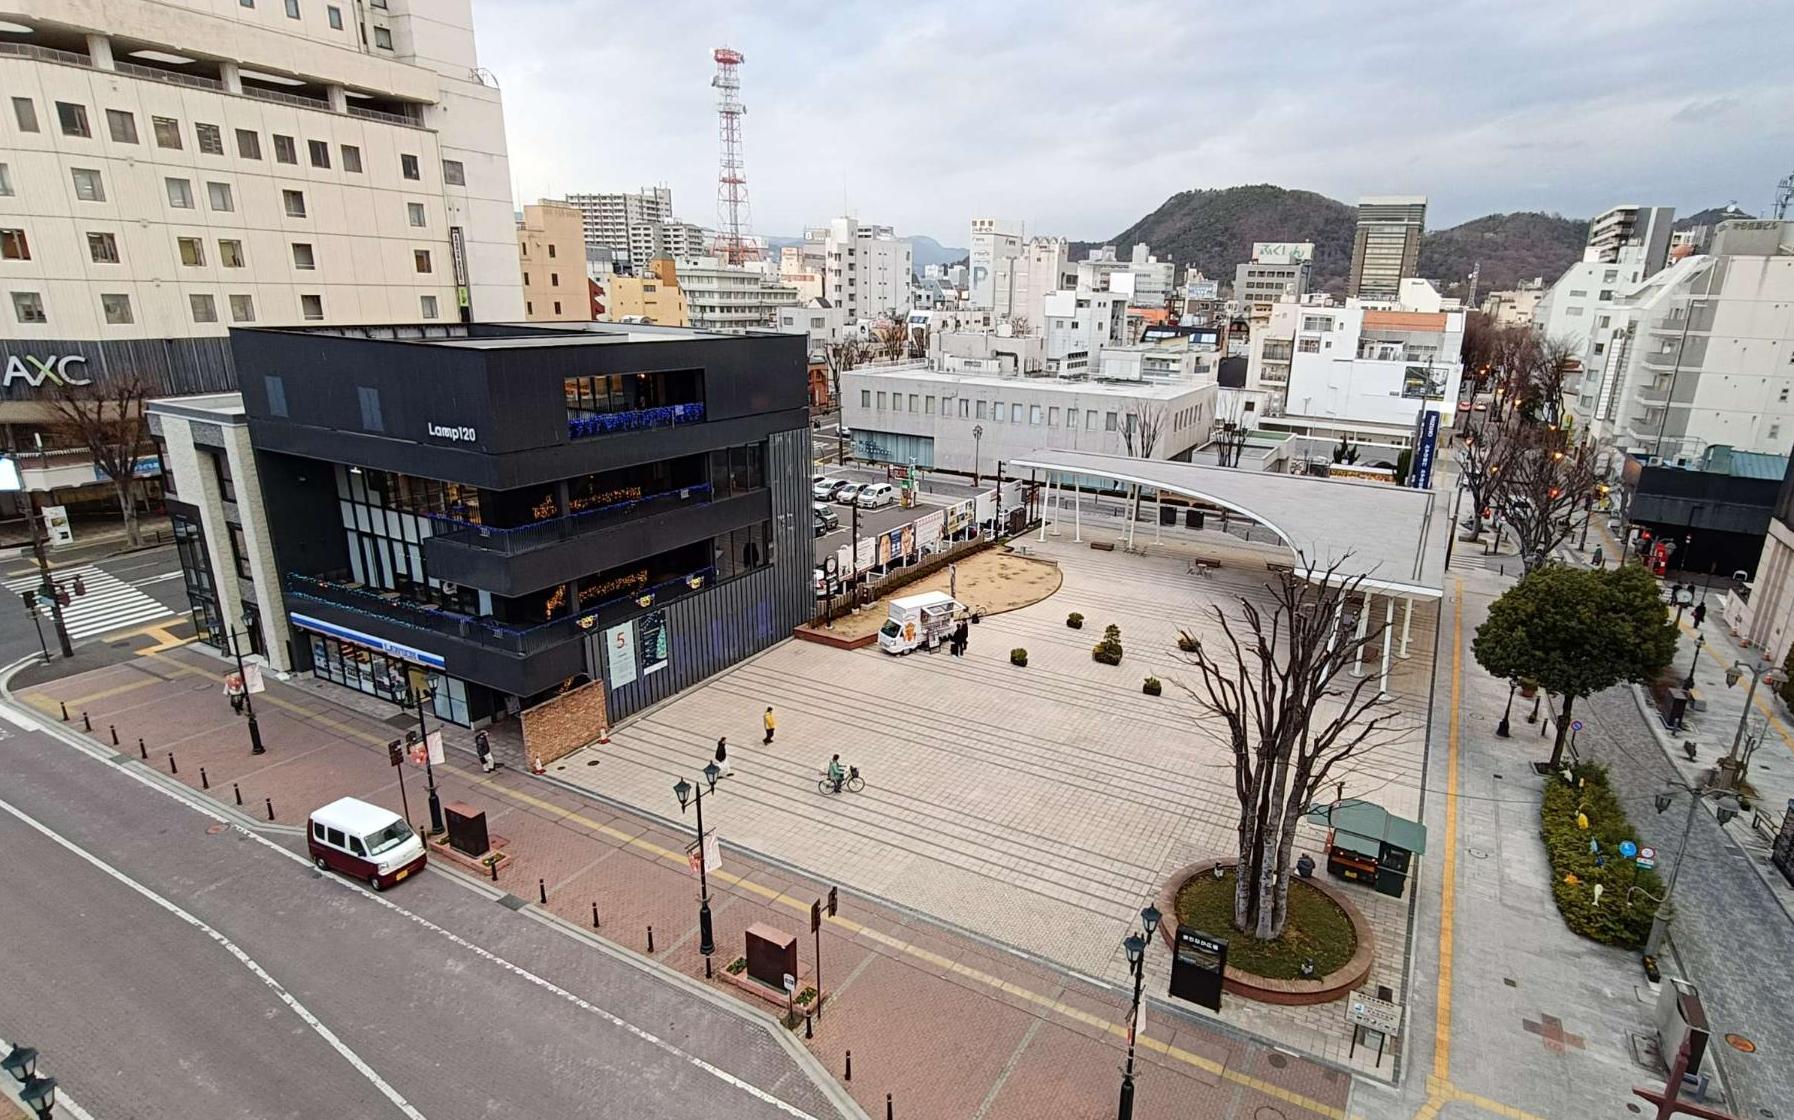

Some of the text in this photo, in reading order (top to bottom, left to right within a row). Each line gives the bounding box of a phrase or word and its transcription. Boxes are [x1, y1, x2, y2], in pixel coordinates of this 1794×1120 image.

[974, 266, 988, 290] P
[3, 354, 93, 387] AXC
[427, 421, 476, 442] Lamp120
[616, 631, 625, 649] 5
